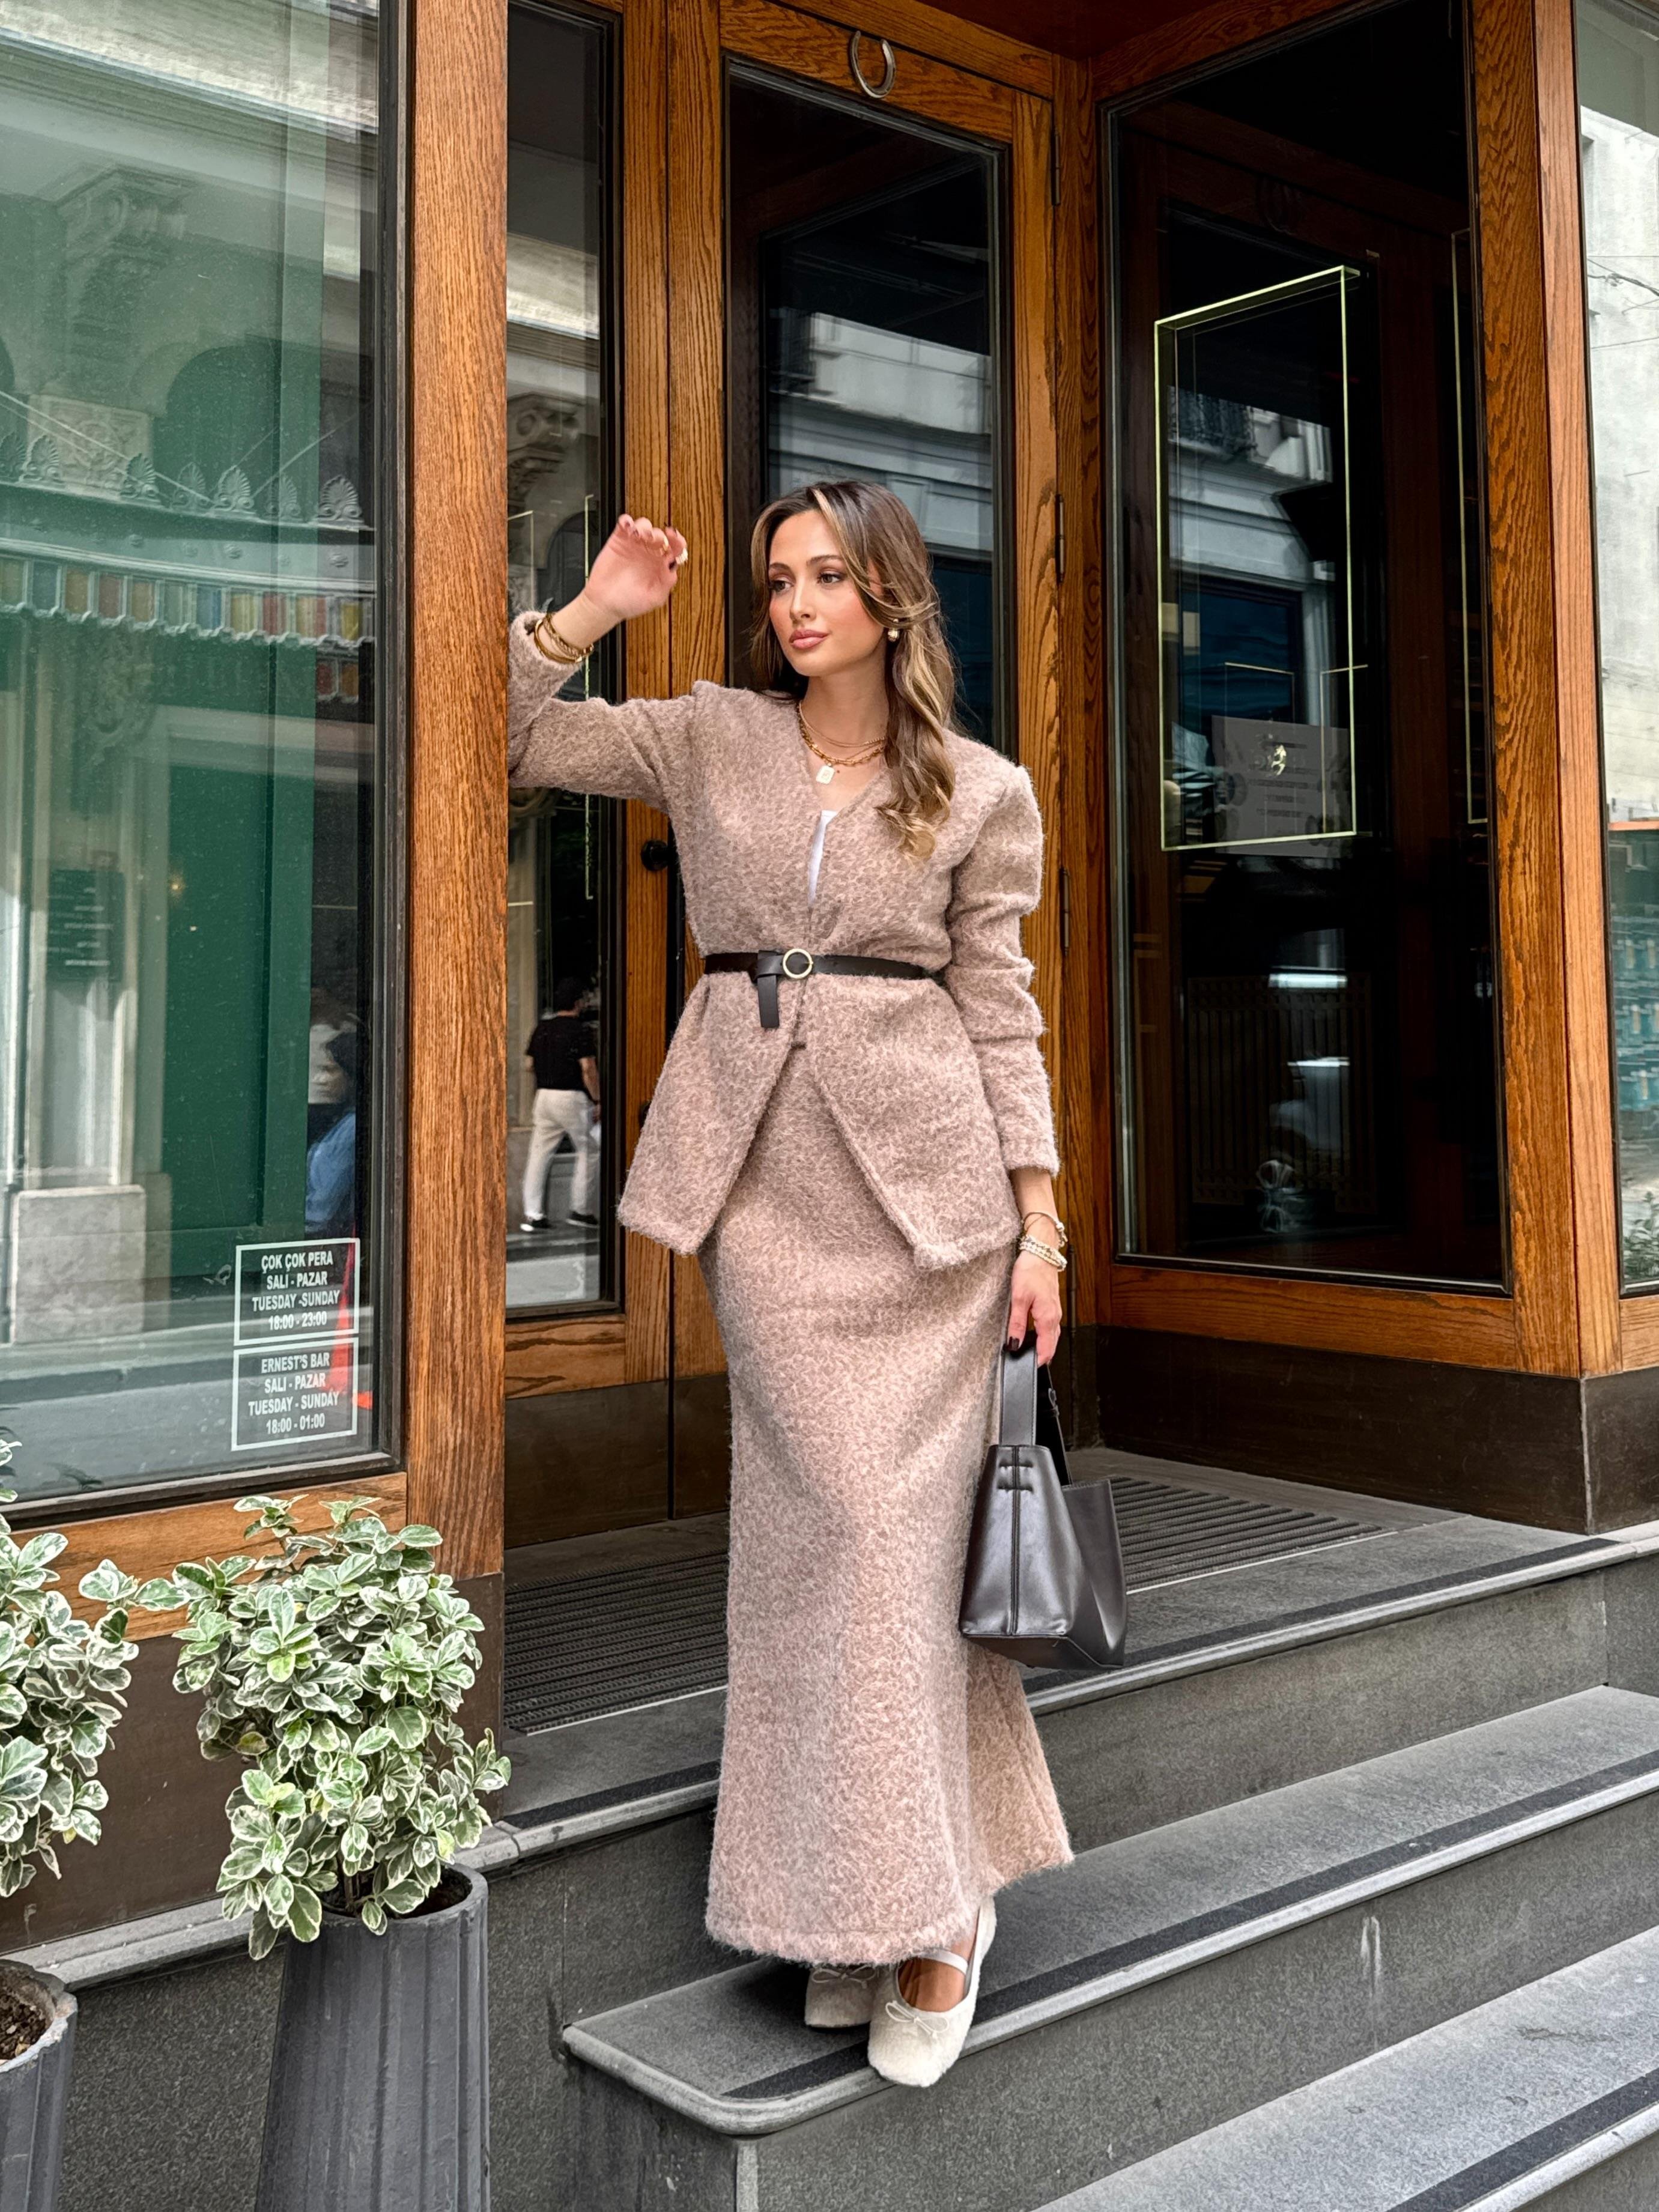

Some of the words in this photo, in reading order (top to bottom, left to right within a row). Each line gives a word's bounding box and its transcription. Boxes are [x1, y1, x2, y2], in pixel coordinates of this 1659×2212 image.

[261, 1255, 282, 1273] ÇOK
[285, 1253, 306, 1271] ÇOK
[308, 1250, 333, 1267] PERA
[267, 1274, 288, 1290] SALI
[297, 1271, 327, 1288] PAZAR
[252, 1293, 297, 1312] TUESDAY
[268, 1314, 294, 1330] 18:00
[302, 1311, 327, 1327] 23:00
[261, 1354, 308, 1374] ERNEST'S
[311, 1352, 330, 1368] BAR
[264, 1377, 287, 1393] SALI
[294, 1373, 326, 1390] PAZAR
[248, 1396, 293, 1416] TUESDAY
[301, 1391, 339, 1410] SUNDAY
[266, 1417, 292, 1434] 18:00
[300, 1413, 325, 1430] 01:00
